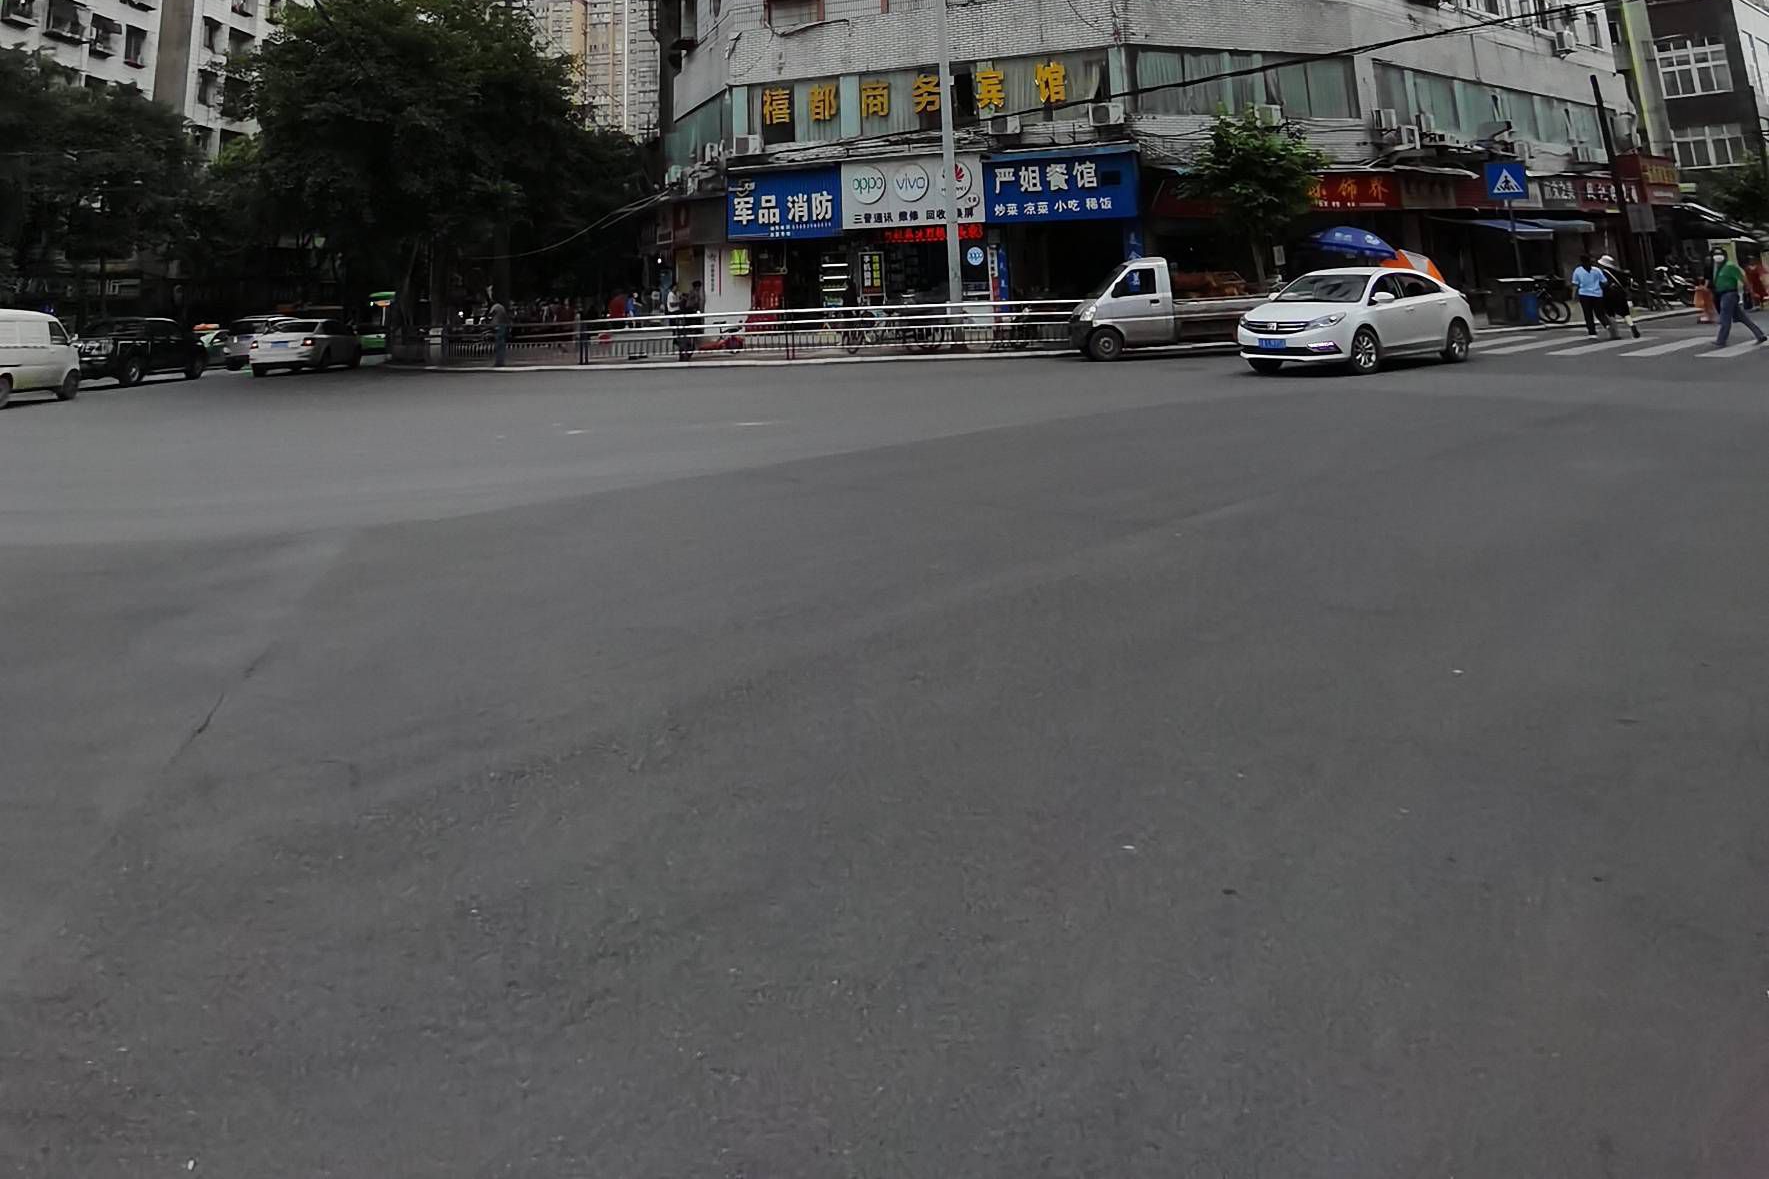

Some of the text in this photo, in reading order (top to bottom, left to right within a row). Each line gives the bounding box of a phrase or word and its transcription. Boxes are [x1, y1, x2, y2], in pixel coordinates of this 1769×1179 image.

[763, 60, 1067, 124] 禧都商务宾馆
[896, 173, 925, 191] vivo
[994, 161, 1098, 194] 严姐餐馆
[733, 190, 833, 225] 军品 消防
[926, 208, 946, 220] 回收
[994, 203, 1019, 217] 炒菜
[1024, 201, 1049, 215] 凉菜
[1054, 199, 1080, 213] 小吃
